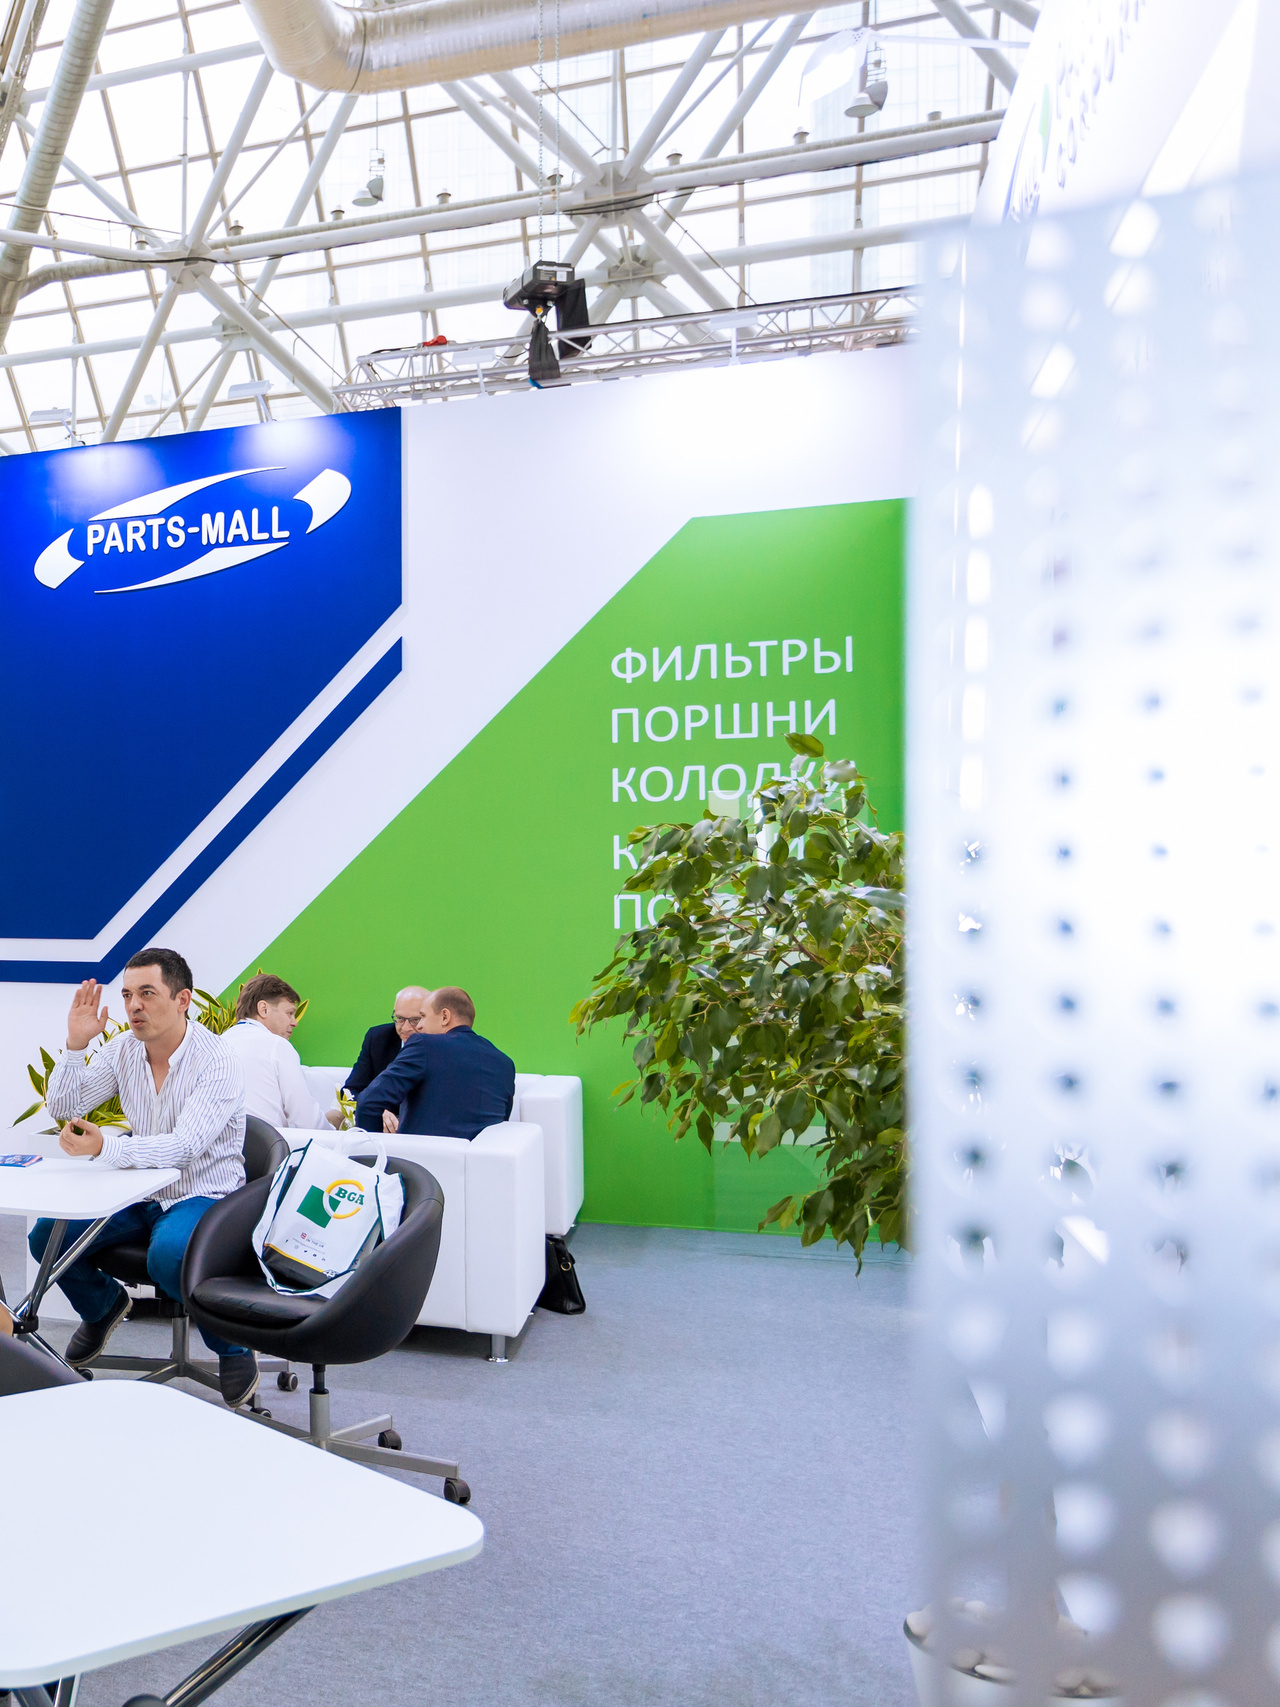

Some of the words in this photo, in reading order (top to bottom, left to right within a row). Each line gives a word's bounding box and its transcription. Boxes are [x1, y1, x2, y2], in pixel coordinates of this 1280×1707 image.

[87, 505, 290, 556] PARTS-MALL
[610, 635, 854, 684] ФИЛЬТРЫ
[611, 698, 837, 743] ПОРШНИ
[335, 1187, 365, 1205] BGA
